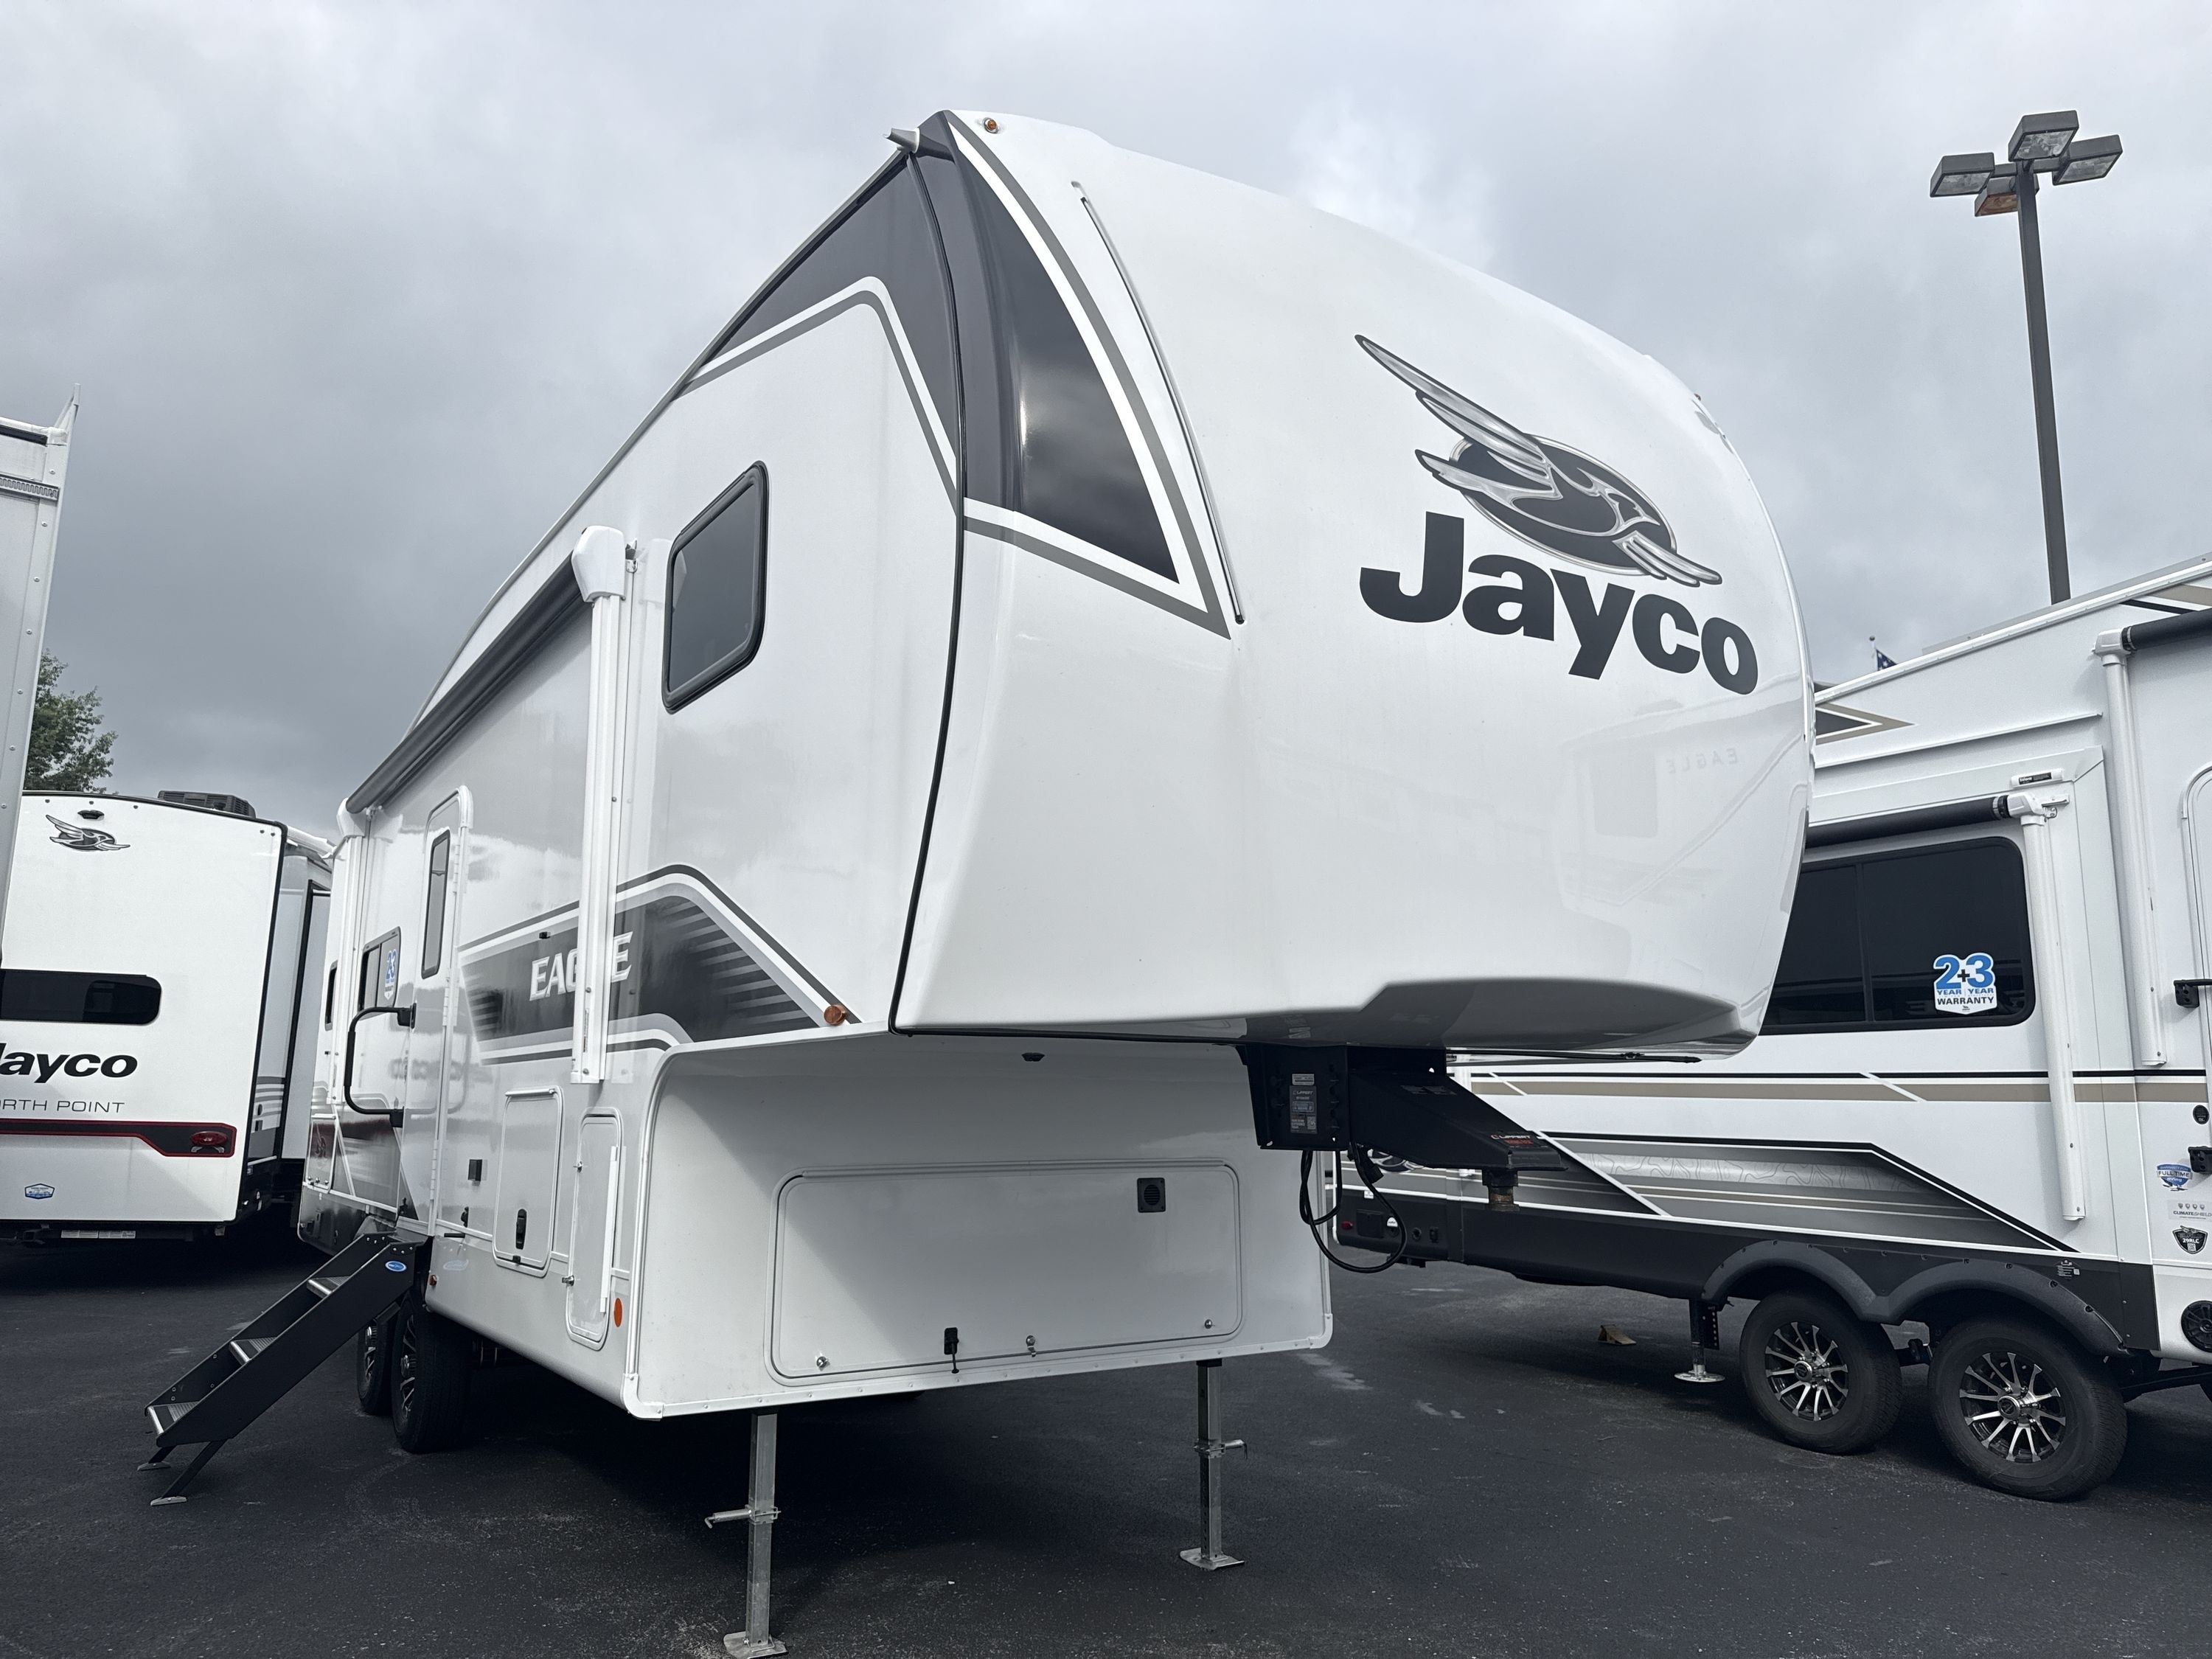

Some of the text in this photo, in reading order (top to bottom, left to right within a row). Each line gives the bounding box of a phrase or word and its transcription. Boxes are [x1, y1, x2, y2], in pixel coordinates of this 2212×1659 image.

[1360, 511, 1759, 695] Jayco
[529, 931, 633, 1001] EAGE
[1937, 997, 1994, 1005] WARRANTY
[0, 1043, 138, 1083] ayco
[0, 1099, 125, 1113] RTH POINT
